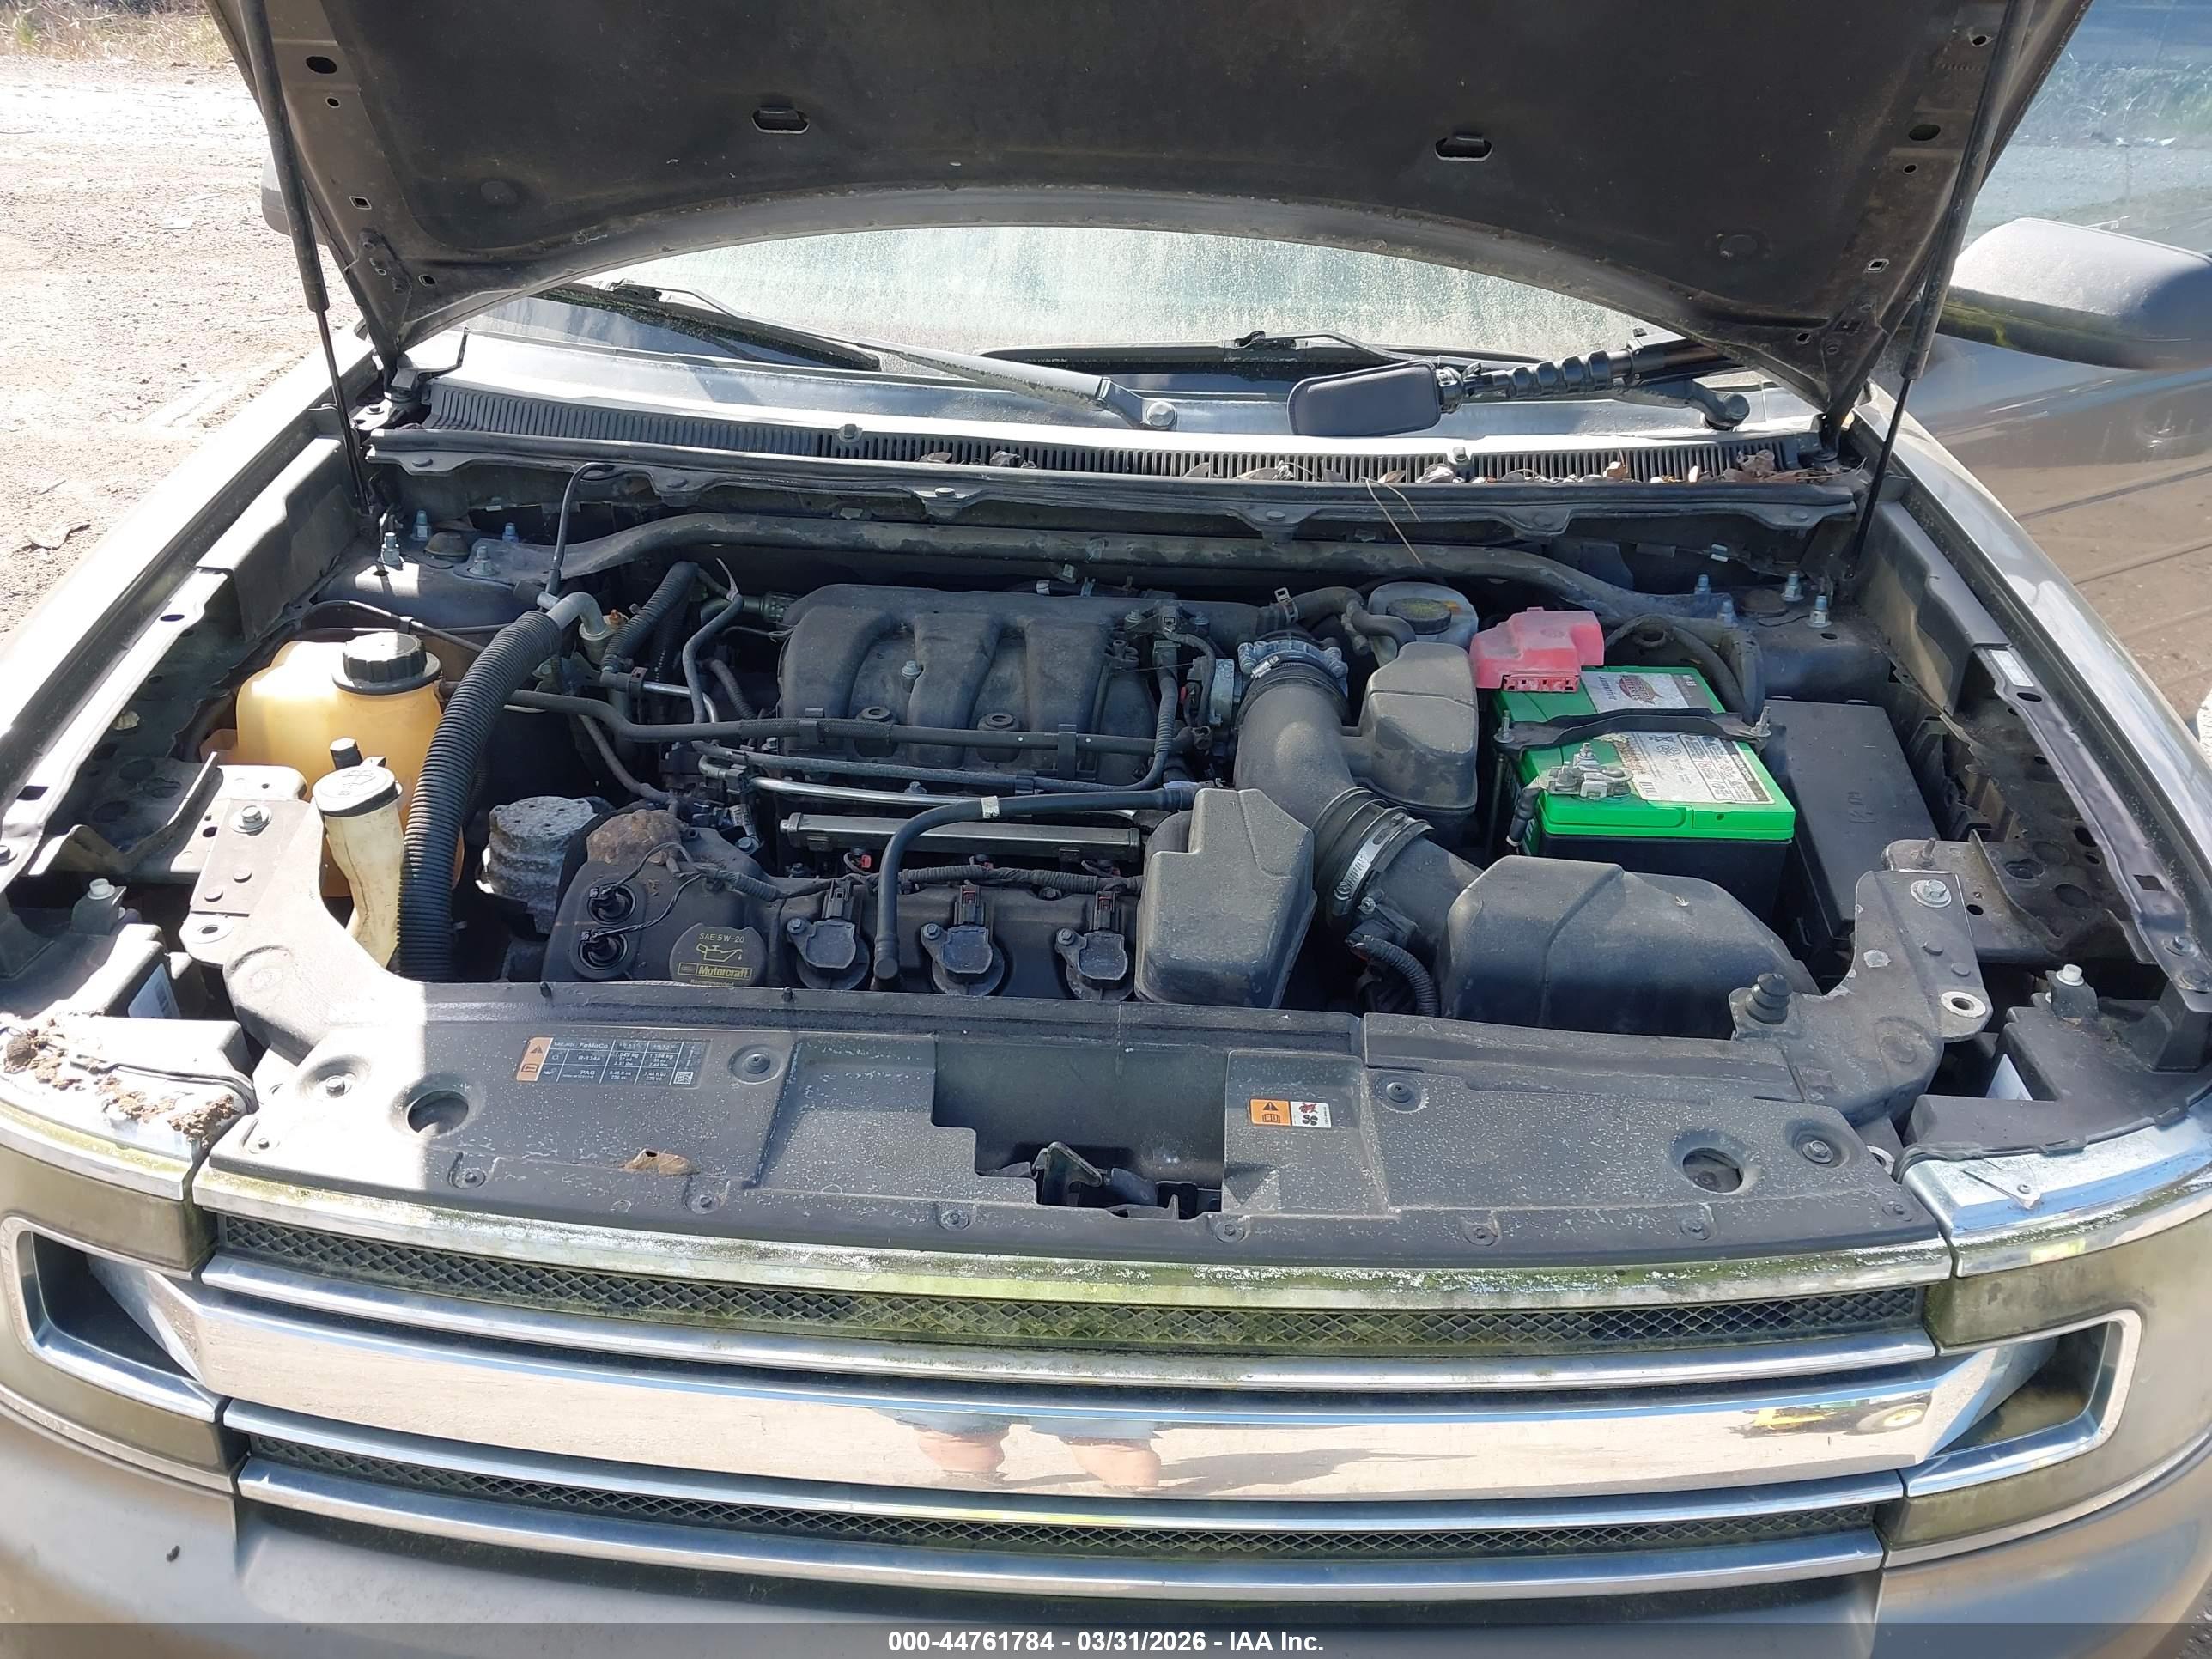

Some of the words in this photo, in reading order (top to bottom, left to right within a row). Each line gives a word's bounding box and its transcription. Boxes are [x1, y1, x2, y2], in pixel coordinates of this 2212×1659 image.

[699, 933, 716, 941] SAE
[717, 933, 745, 943] 5W-20
[698, 965, 748, 978] Motorcraft
